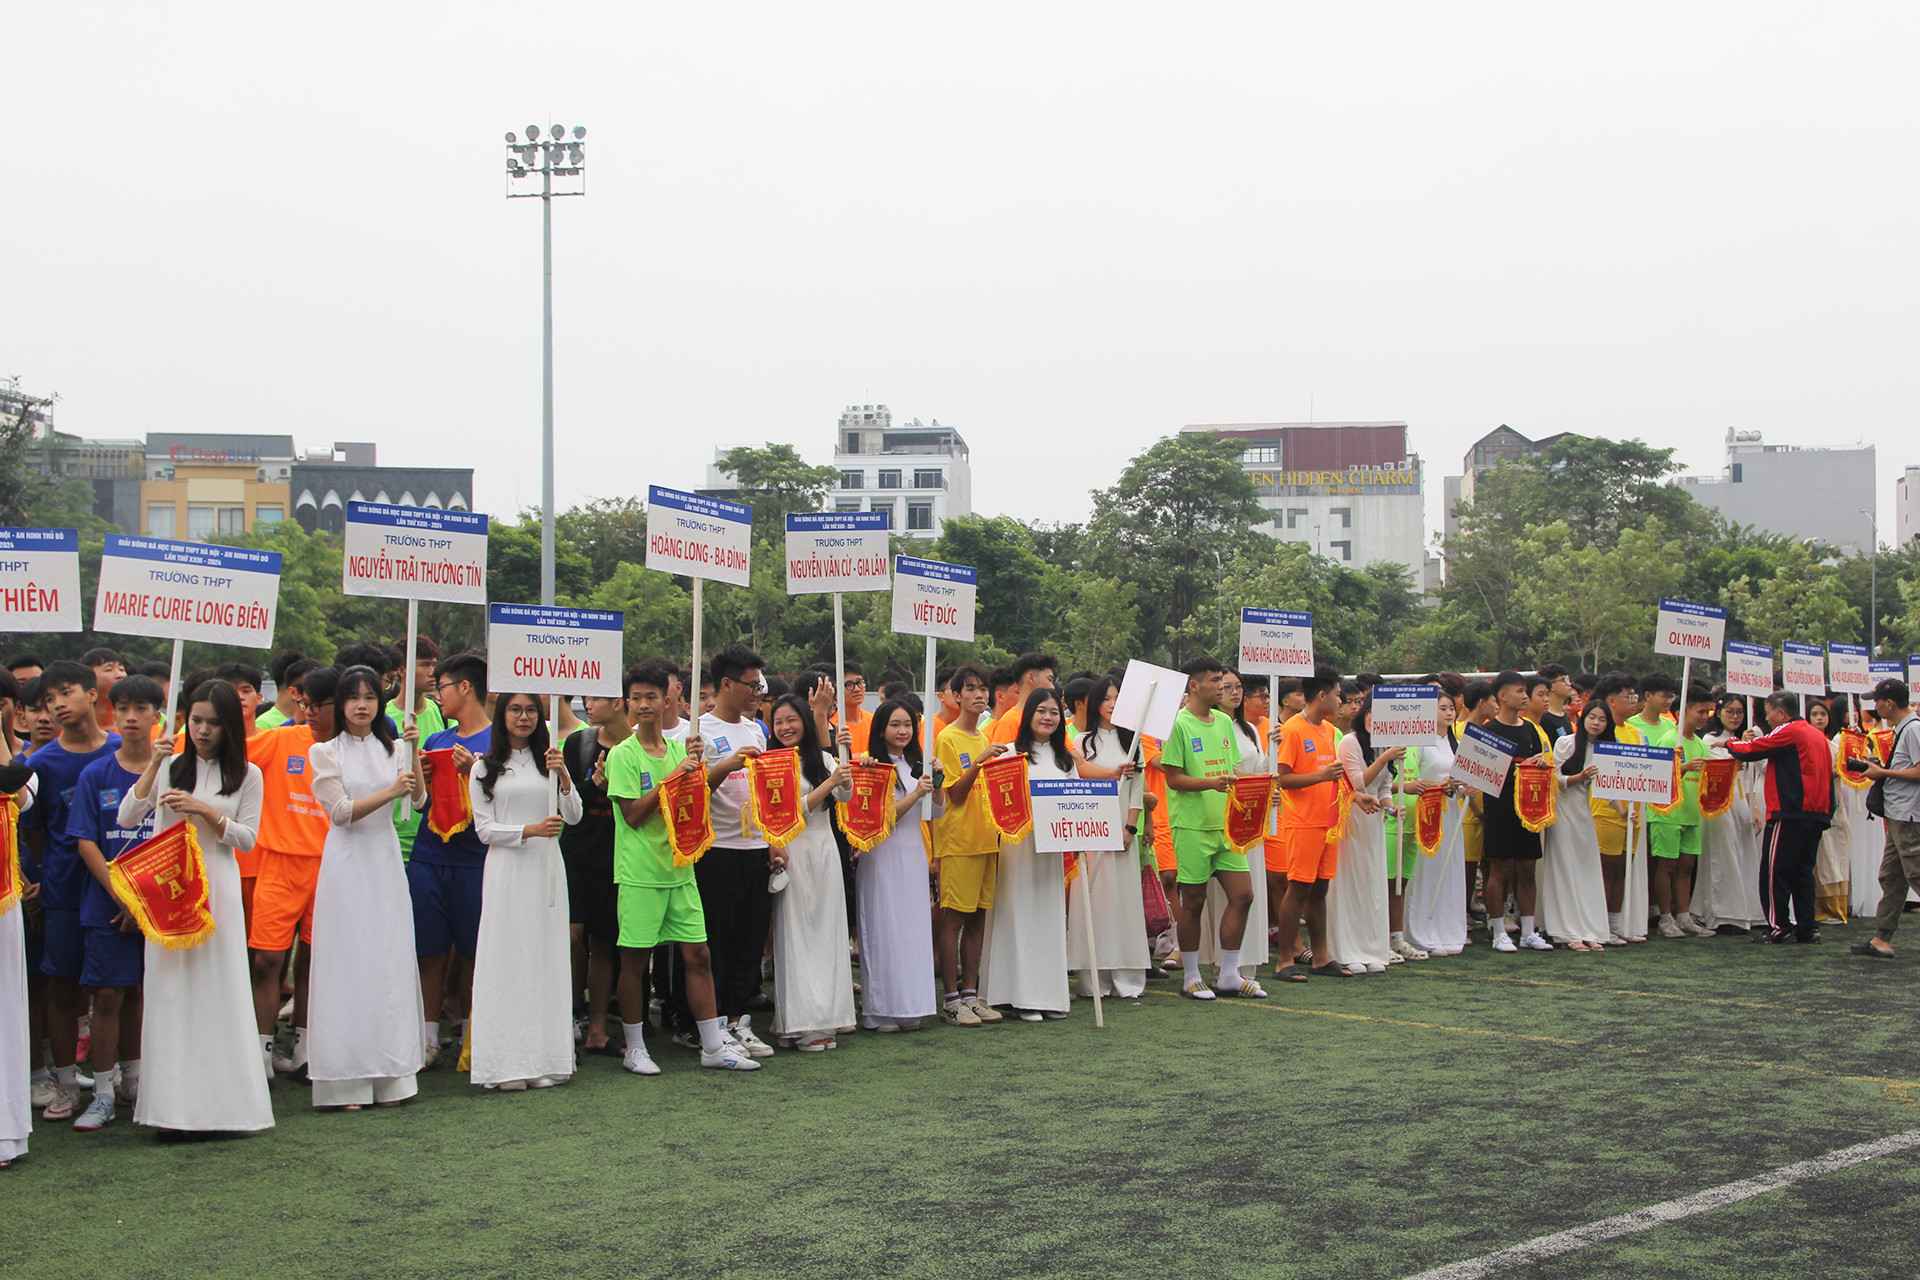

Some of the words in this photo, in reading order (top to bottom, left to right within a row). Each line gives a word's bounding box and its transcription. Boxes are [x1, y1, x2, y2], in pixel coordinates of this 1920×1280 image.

[1280, 471, 1343, 486] HIDDEN
[1349, 471, 1413, 485] CHARM
[676, 518, 706, 531] TRƯỜNG
[709, 524, 725, 534] THPT
[43, 530, 54, 540] THỦ
[385, 535, 425, 547] TRƯỜNG
[429, 539, 451, 549] THPT
[815, 538, 844, 546] TRƯỜNG
[169, 545, 184, 553] SINH
[651, 532, 682, 558] HOÀNG
[685, 542, 708, 562] LONG
[715, 547, 725, 566] BA
[727, 546, 746, 569] ĐÌNH
[350, 548, 392, 579] NGUYỄN
[396, 555, 418, 581] TRÃI
[421, 558, 463, 585] THƯỜNG
[466, 560, 481, 586] TÍN
[791, 552, 822, 578] NGUYỄN
[824, 555, 840, 576] VĂN
[842, 554, 852, 576] CỪ
[857, 558, 870, 576] GIA
[871, 554, 886, 575] LÂM
[149, 570, 198, 584] TRƯỜNG
[203, 576, 232, 588] THPT
[917, 584, 940, 594] TRƯỜNG
[942, 587, 955, 596] THPT
[104, 591, 150, 617] MARIE
[153, 596, 193, 621] CURIE
[196, 601, 234, 626] LONG
[237, 601, 268, 629] BIÊN
[914, 600, 934, 624] VIỆT
[936, 603, 956, 625] ĐỨC
[527, 633, 564, 644] TRƯỜNG
[568, 637, 589, 645] THPT
[1669, 632, 1710, 648] OLYMPIA
[514, 657, 543, 677] CHU
[548, 654, 577, 678] VĂN
[581, 660, 600, 679] AN
[1373, 721, 1387, 735] PHAN
[1389, 720, 1400, 734] HUY
[1401, 717, 1411, 735] CHÚ
[1412, 716, 1426, 734] ĐỐNG
[1428, 720, 1435, 734] ĐA
[1456, 754, 1470, 771] PHAN
[1470, 761, 1484, 777] ĐÌNH
[1487, 766, 1503, 787] PHÙNG
[1596, 770, 1625, 790] NGUYỄN
[1627, 774, 1646, 791] QUỐC
[1648, 779, 1667, 792] TRINH
[770, 789, 781, 803] A
[861, 796, 868, 810] A
[1005, 792, 1012, 806] A
[1532, 792, 1538, 802] A
[677, 807, 691, 822] A
[1244, 809, 1252, 820] A
[1051, 817, 1073, 841] VIỆT
[1076, 817, 1108, 837] HOÀNG
[168, 880, 185, 900] A
